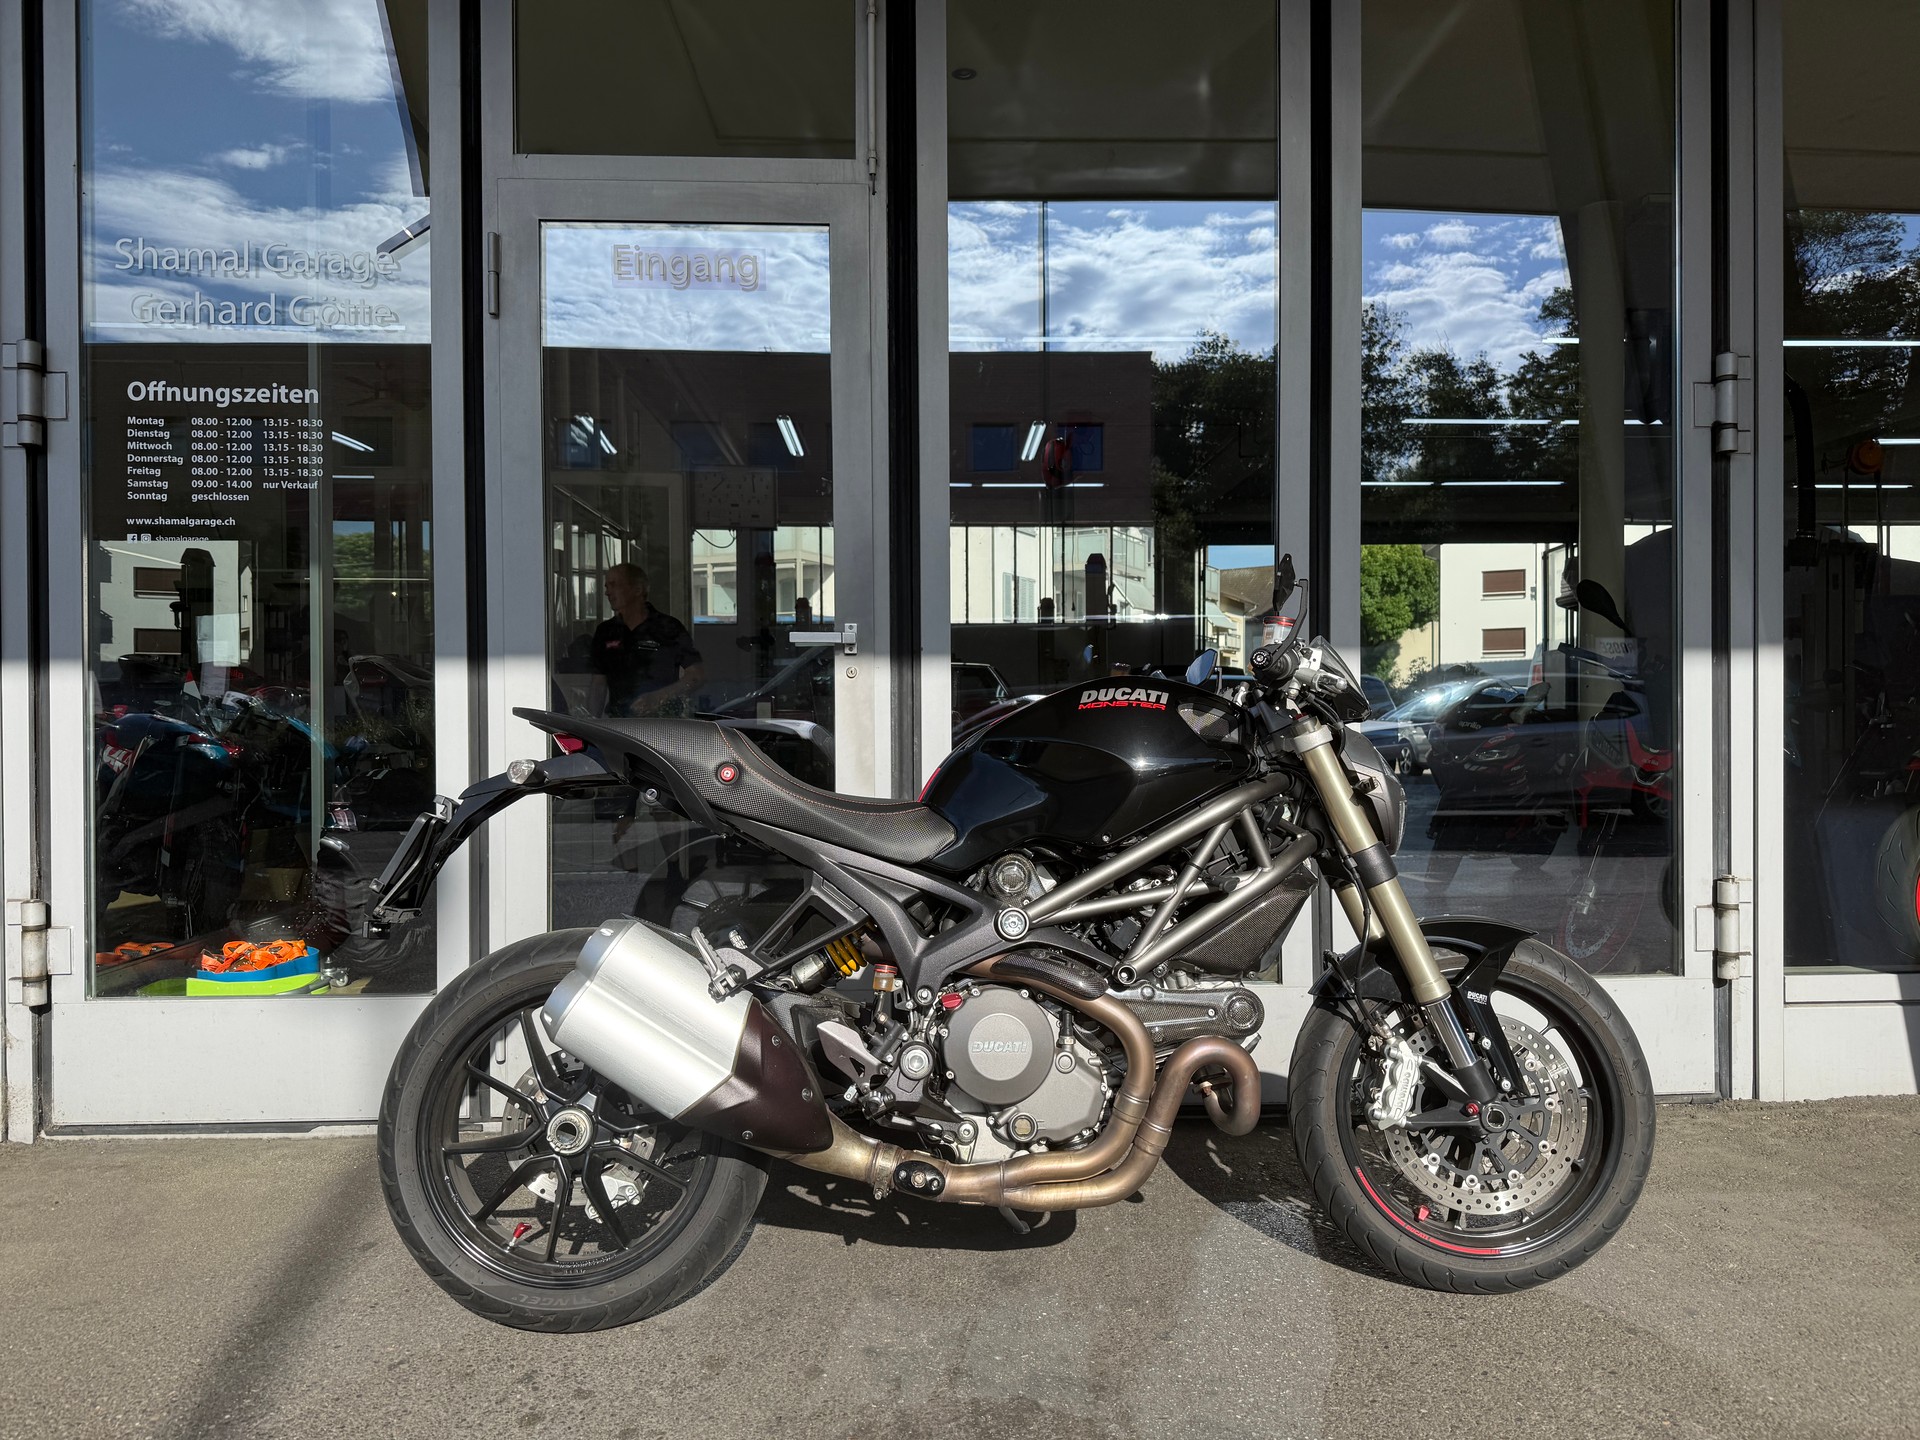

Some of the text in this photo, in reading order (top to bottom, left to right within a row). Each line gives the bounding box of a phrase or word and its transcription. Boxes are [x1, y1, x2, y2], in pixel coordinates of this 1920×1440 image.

[114, 237, 395, 284] Shamal Garage
[612, 244, 760, 289] Eingang
[130, 291, 276, 326] Gerhard
[127, 416, 165, 427] Montag
[191, 417, 219, 426] 08.00
[226, 417, 253, 426] 12.00
[263, 418, 290, 427] 13.15
[297, 418, 324, 427] 18.30
[127, 429, 170, 440] Dienstag
[191, 430, 219, 439] 08.00
[226, 430, 253, 439] 12.00
[263, 431, 290, 440] 13.15
[297, 431, 324, 440] 18.30
[127, 442, 173, 450] Mittwoch
[191, 442, 219, 451] 08.00
[226, 442, 253, 451] 12.00
[263, 443, 290, 452] 13.15
[297, 443, 324, 452] 18.30
[127, 454, 184, 465] Donnerstag
[191, 455, 219, 464] 08.00
[226, 455, 253, 464] 12.00
[263, 456, 290, 465] 13.15
[297, 456, 324, 465] 18.30
[127, 467, 161, 477] Freitag
[191, 467, 219, 476] 08.00
[226, 467, 253, 476] 12.00
[263, 468, 290, 477] 13.15
[297, 468, 324, 477] 18.30
[127, 479, 169, 490] Samstag
[191, 480, 219, 488] 09.00
[226, 480, 253, 489] 14.00
[280, 480, 319, 489] Verkauf
[127, 491, 250, 503] Sonntag geschlossen
[126, 516, 236, 528] www.shamalgarage.ch
[1079, 687, 1170, 705] DUCATI
[1077, 700, 1167, 711] MONSTER
[1467, 991, 1488, 1002] DUCATI
[972, 1041, 1028, 1053] DUCATI
